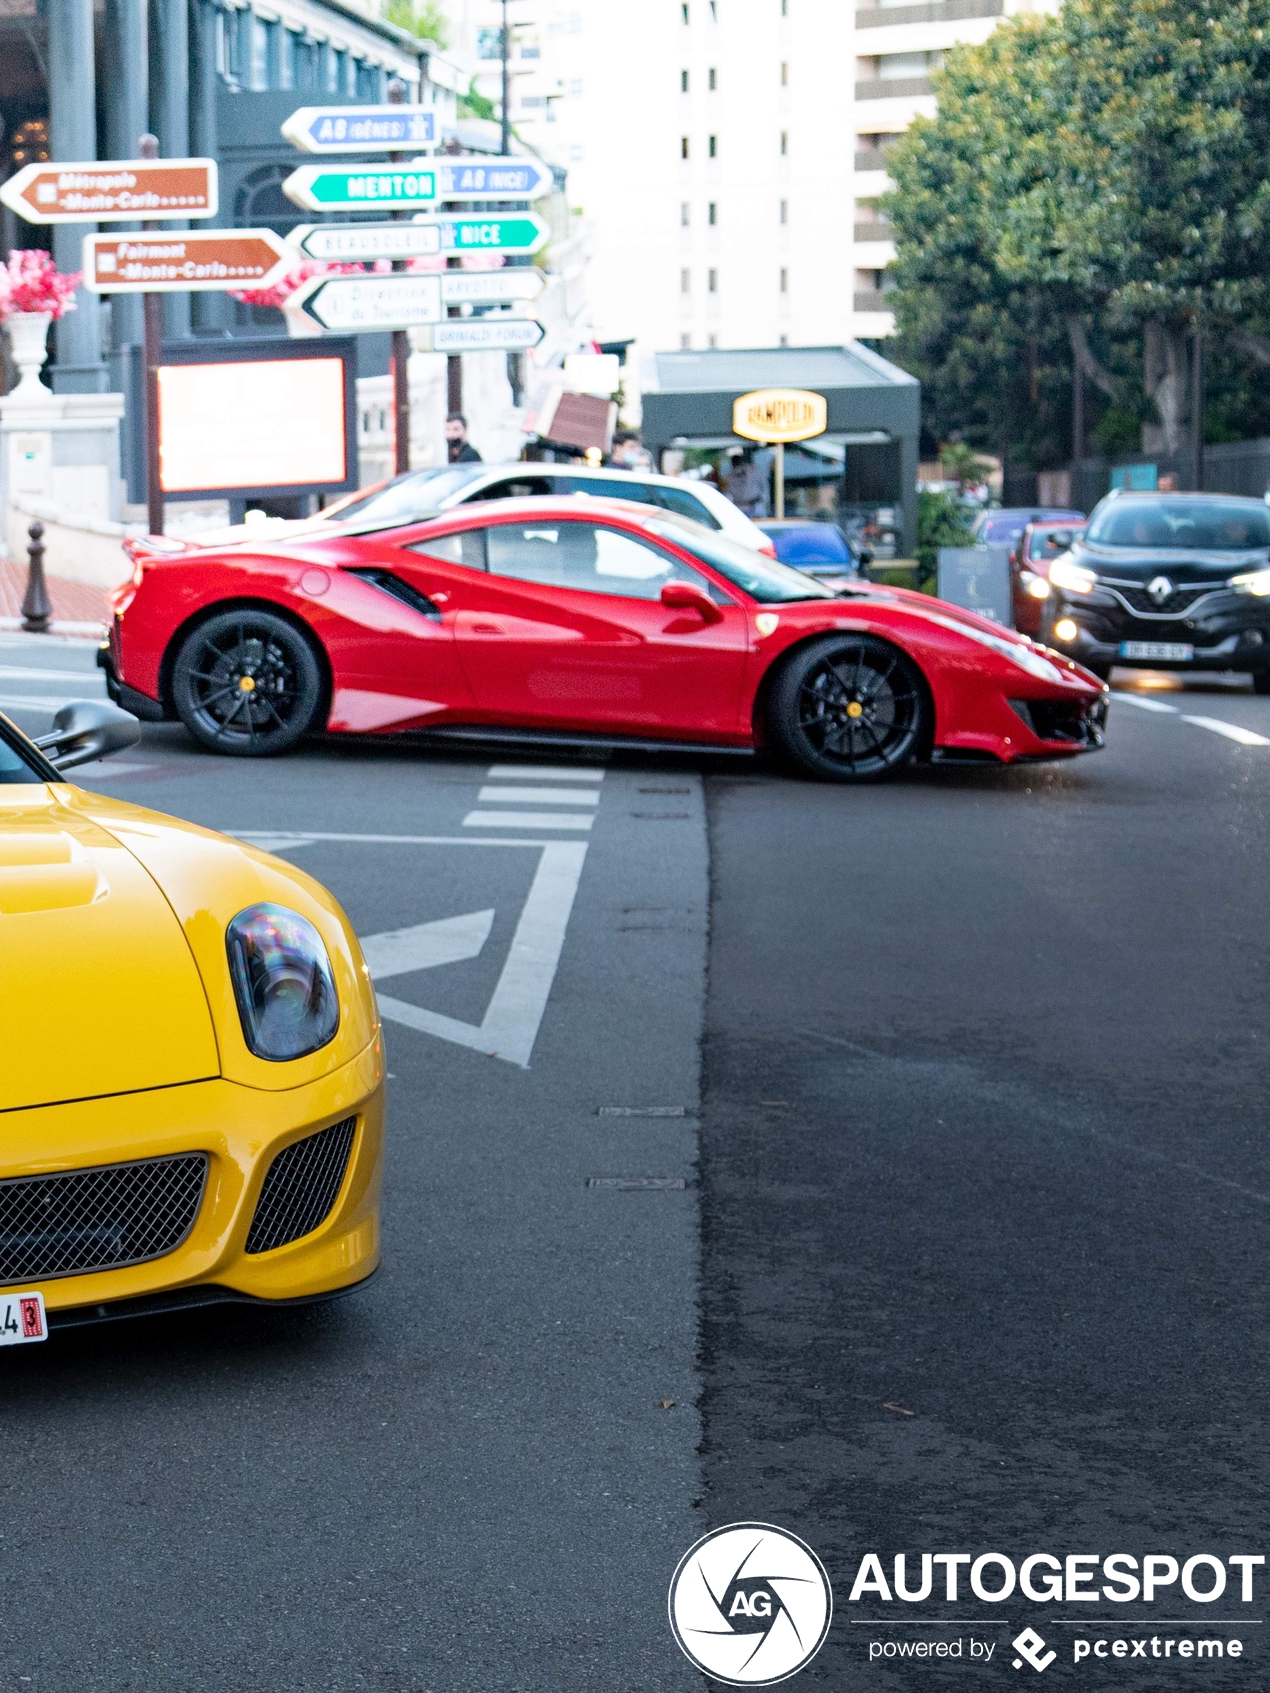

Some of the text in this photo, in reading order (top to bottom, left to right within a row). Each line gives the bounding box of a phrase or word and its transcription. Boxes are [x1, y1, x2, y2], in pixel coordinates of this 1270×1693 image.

[347, 176, 432, 198] MENTON
[488, 170, 529, 189] (NICE)
[325, 233, 430, 250] BEAUSOLEIL
[460, 224, 502, 245] NICE
[117, 242, 186, 260] Fairmont
[351, 285, 429, 301] Direction
[373, 304, 429, 319] Tourisme
[25, 1306, 36, 1327] 3
